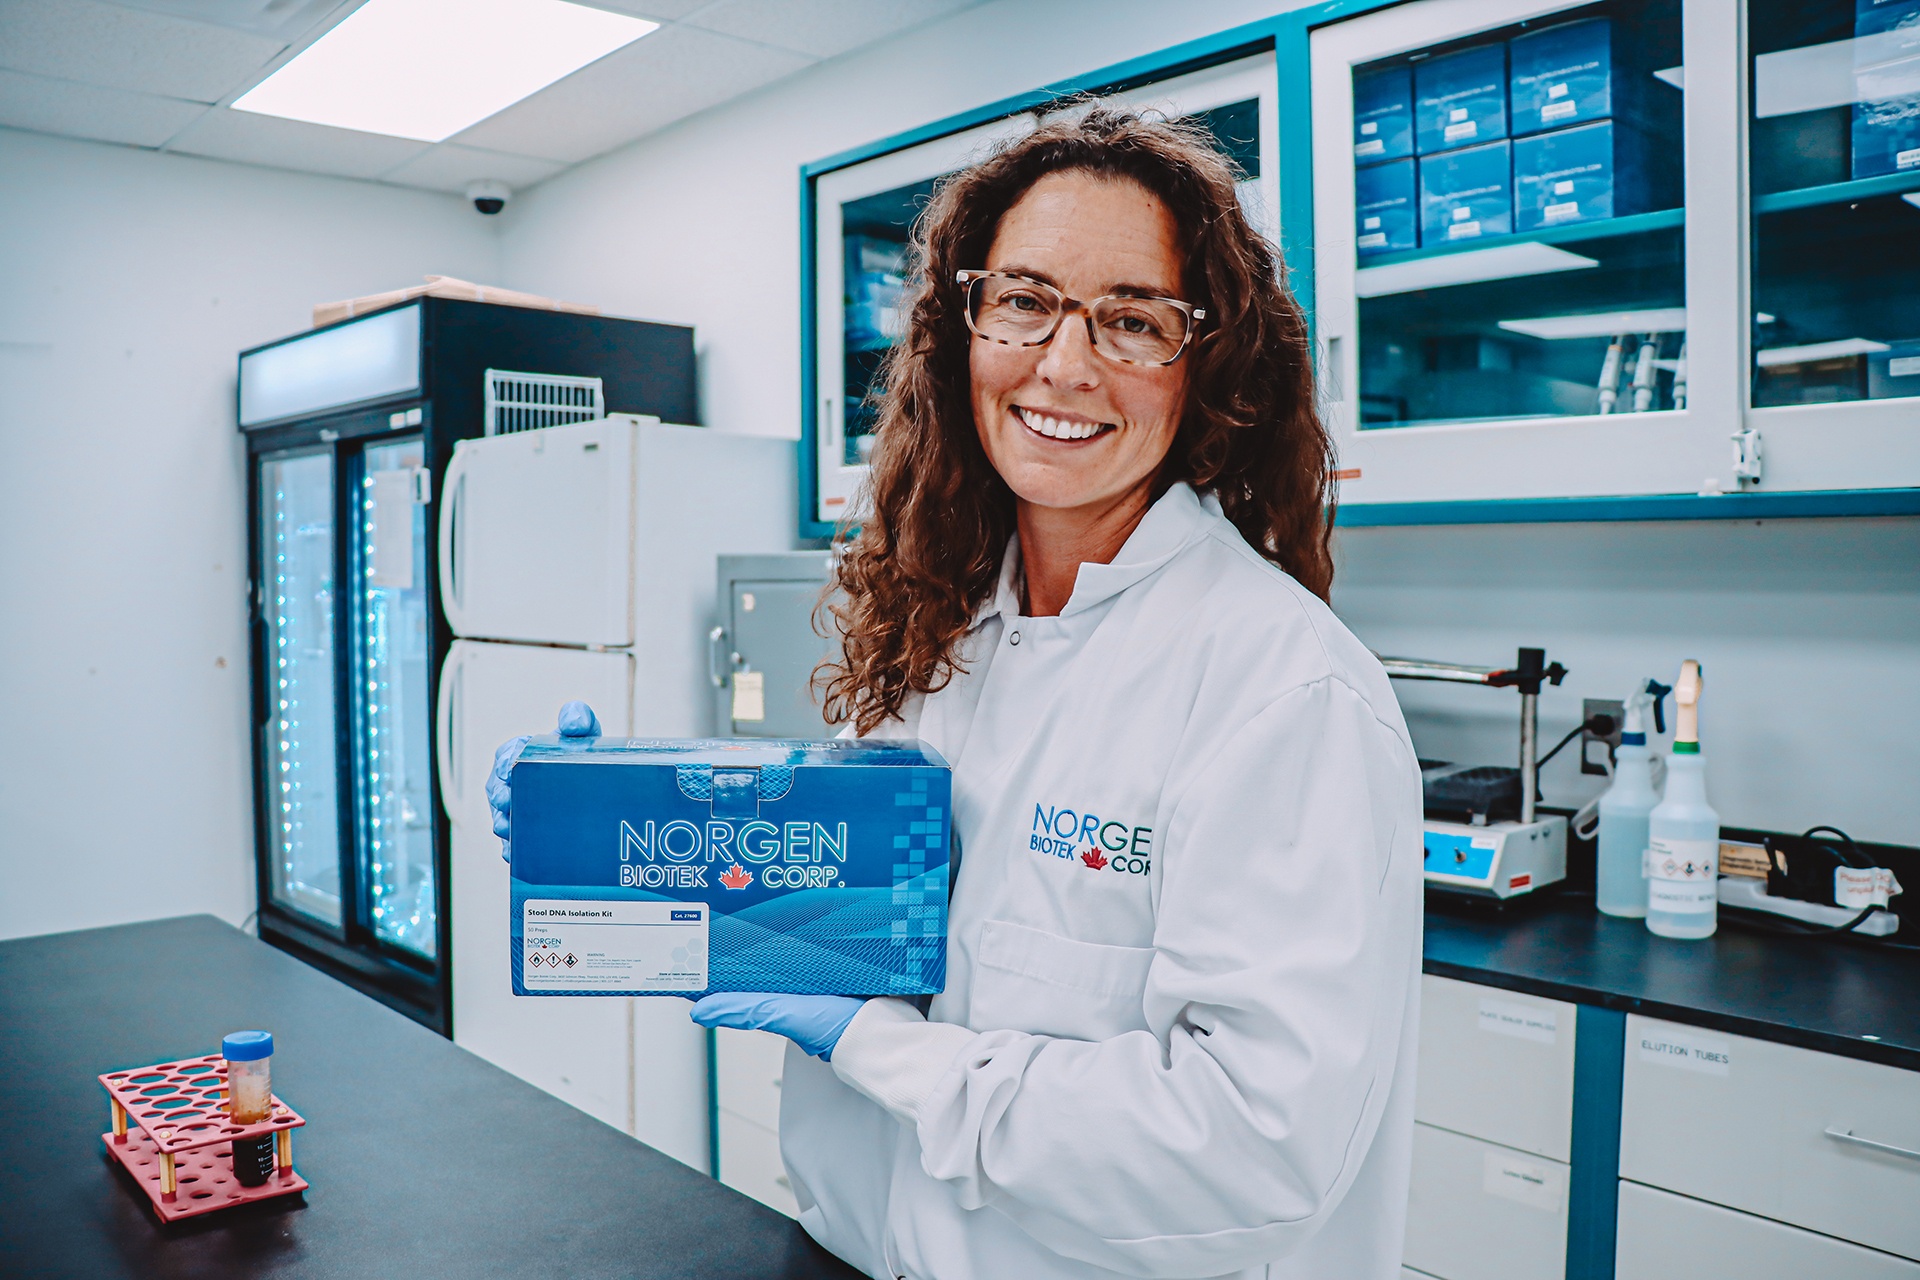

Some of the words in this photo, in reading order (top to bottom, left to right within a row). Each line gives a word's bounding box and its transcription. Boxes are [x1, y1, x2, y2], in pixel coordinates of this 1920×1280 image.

[620, 820, 847, 863] NORGEN
[1032, 802, 1153, 857] NORGE
[1029, 833, 1077, 861] BIOTEK
[620, 864, 708, 887] BIOTEK
[762, 865, 846, 888] CORP.
[549, 909, 567, 917] DNA
[1641, 1039, 1688, 1056] ELUTION
[1694, 1049, 1729, 1064] TUBES
